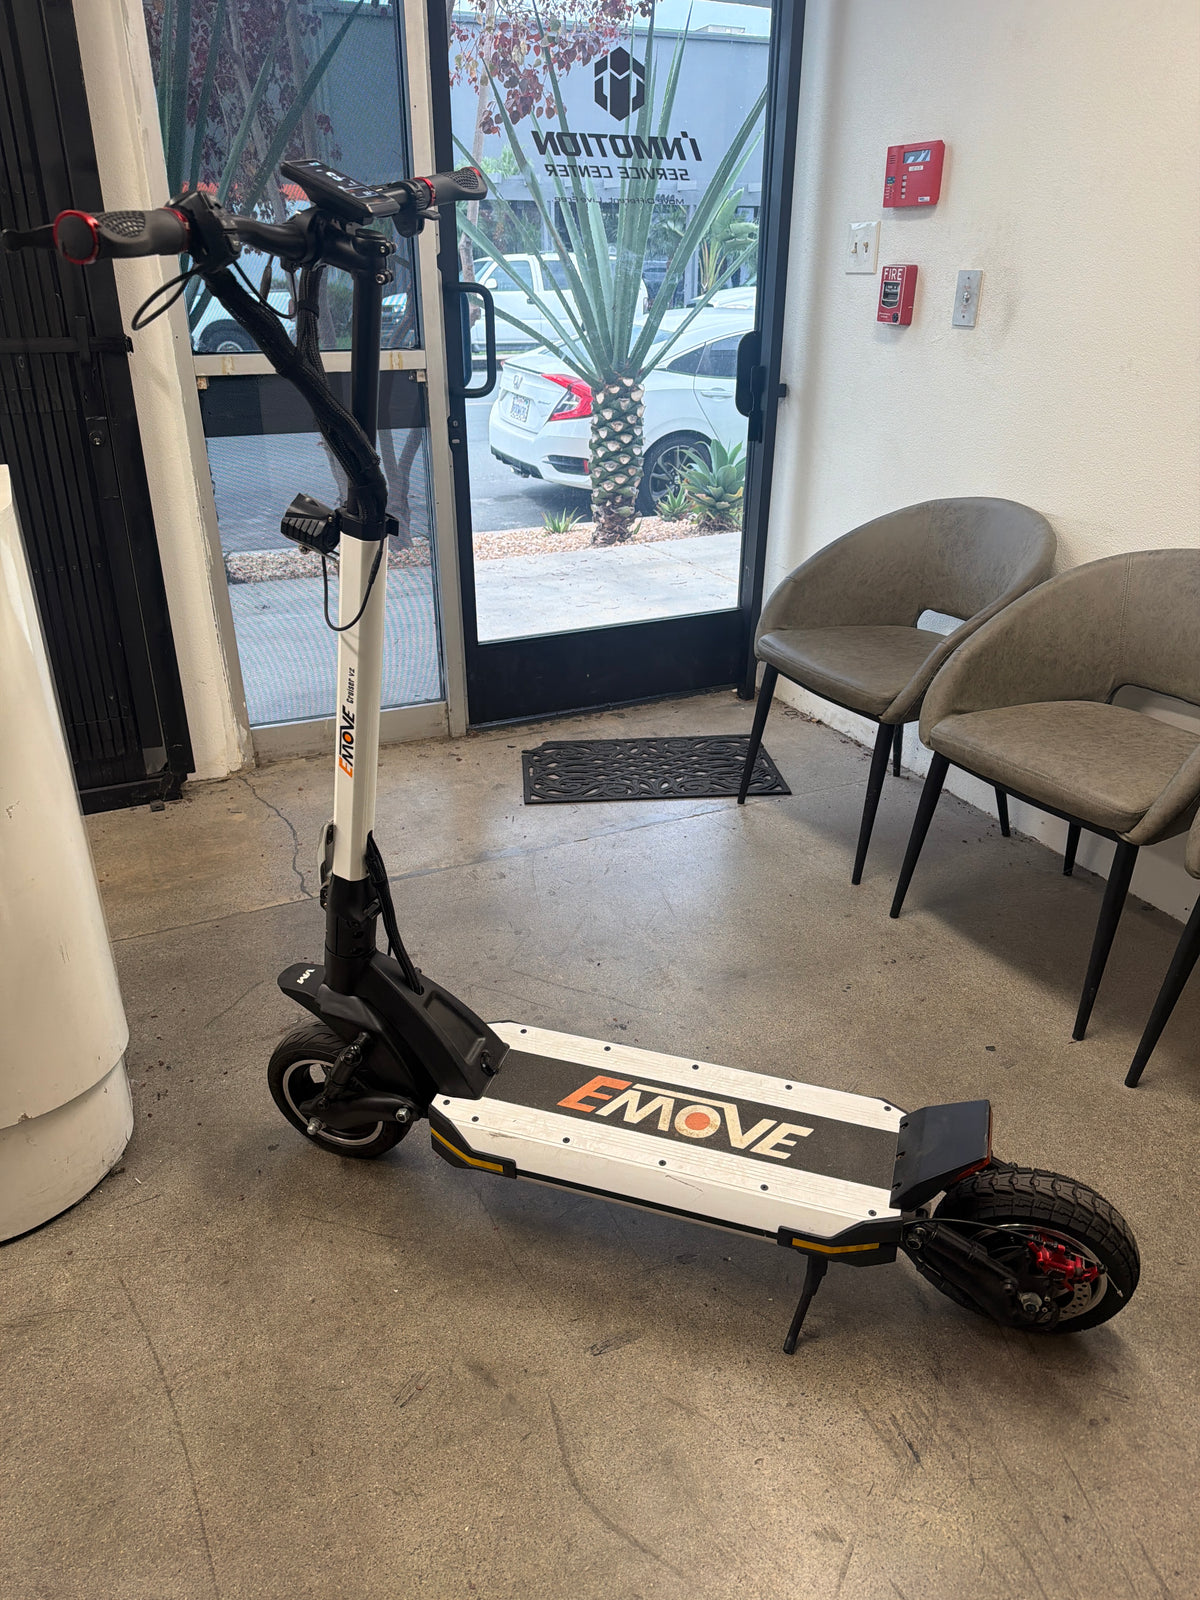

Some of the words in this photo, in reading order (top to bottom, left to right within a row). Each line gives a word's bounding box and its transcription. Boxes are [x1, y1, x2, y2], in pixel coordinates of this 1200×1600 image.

[883, 267, 903, 281] FIRE
[346, 678, 355, 704] Cruiser
[338, 704, 355, 778] EMOVE
[556, 1074, 815, 1160] EMOVE
